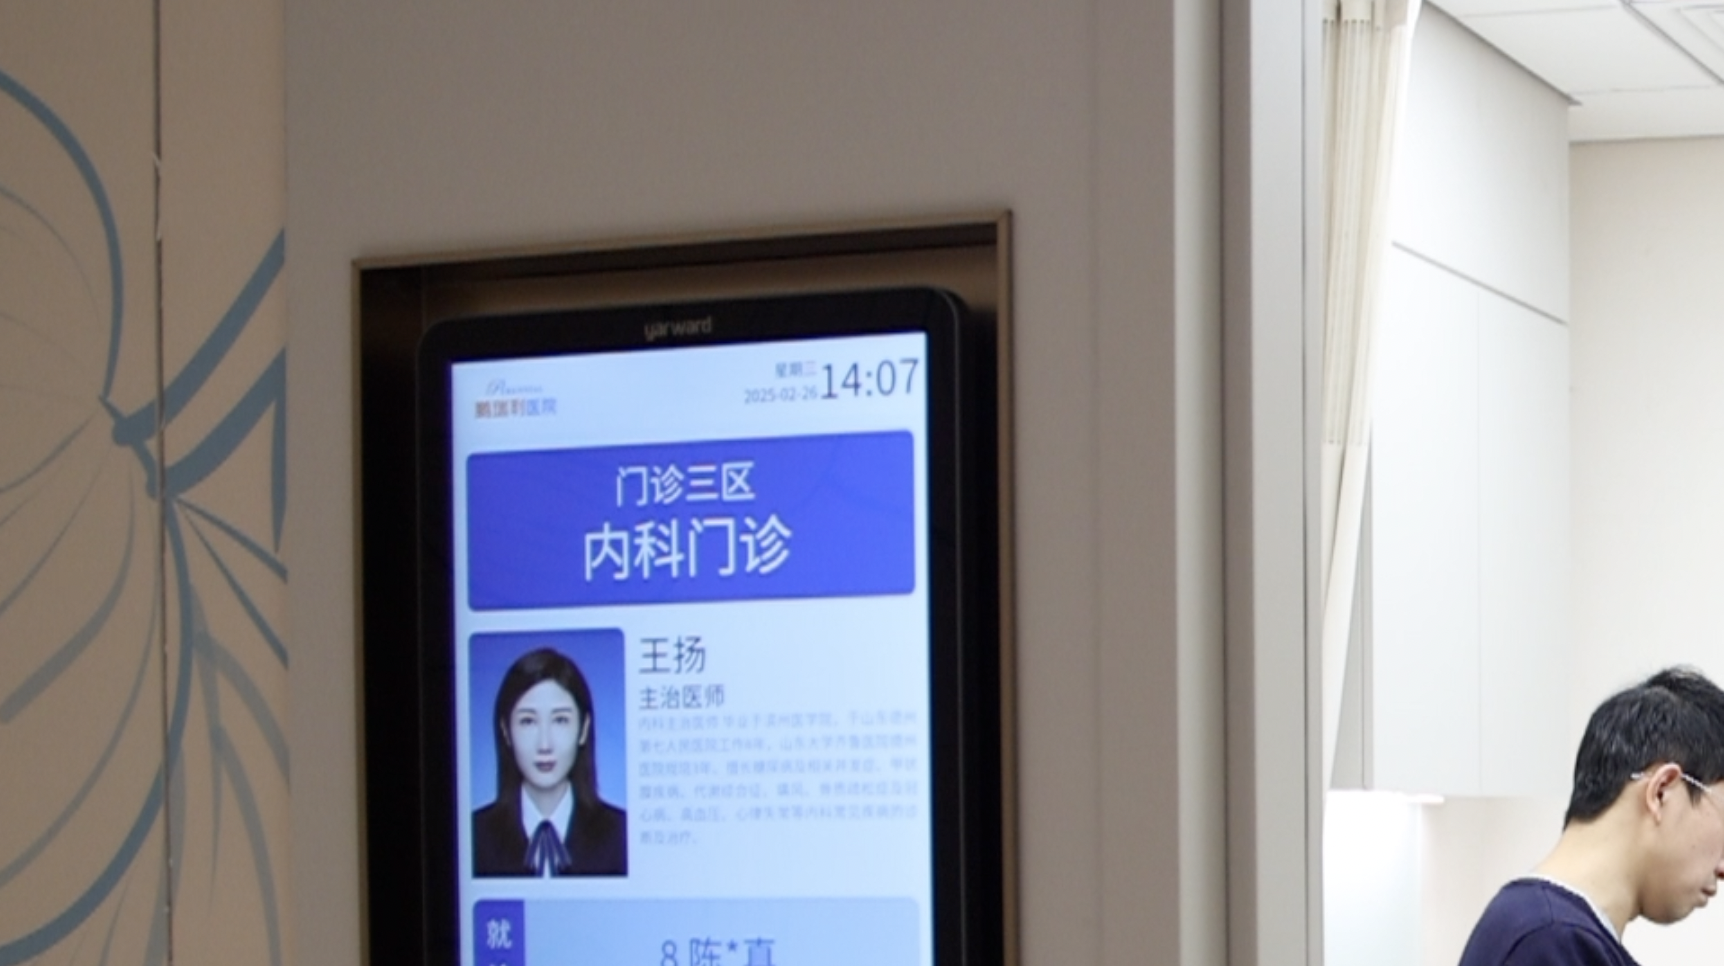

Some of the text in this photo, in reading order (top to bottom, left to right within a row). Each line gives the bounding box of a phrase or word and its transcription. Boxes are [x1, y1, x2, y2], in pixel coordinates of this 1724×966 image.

[643, 315, 712, 341] yarward
[821, 358, 919, 400] 14:07
[616, 461, 756, 507] 门诊三区
[584, 514, 792, 581] 内科门诊
[638, 636, 707, 675] 王扬
[638, 683, 725, 710] 主治医师
